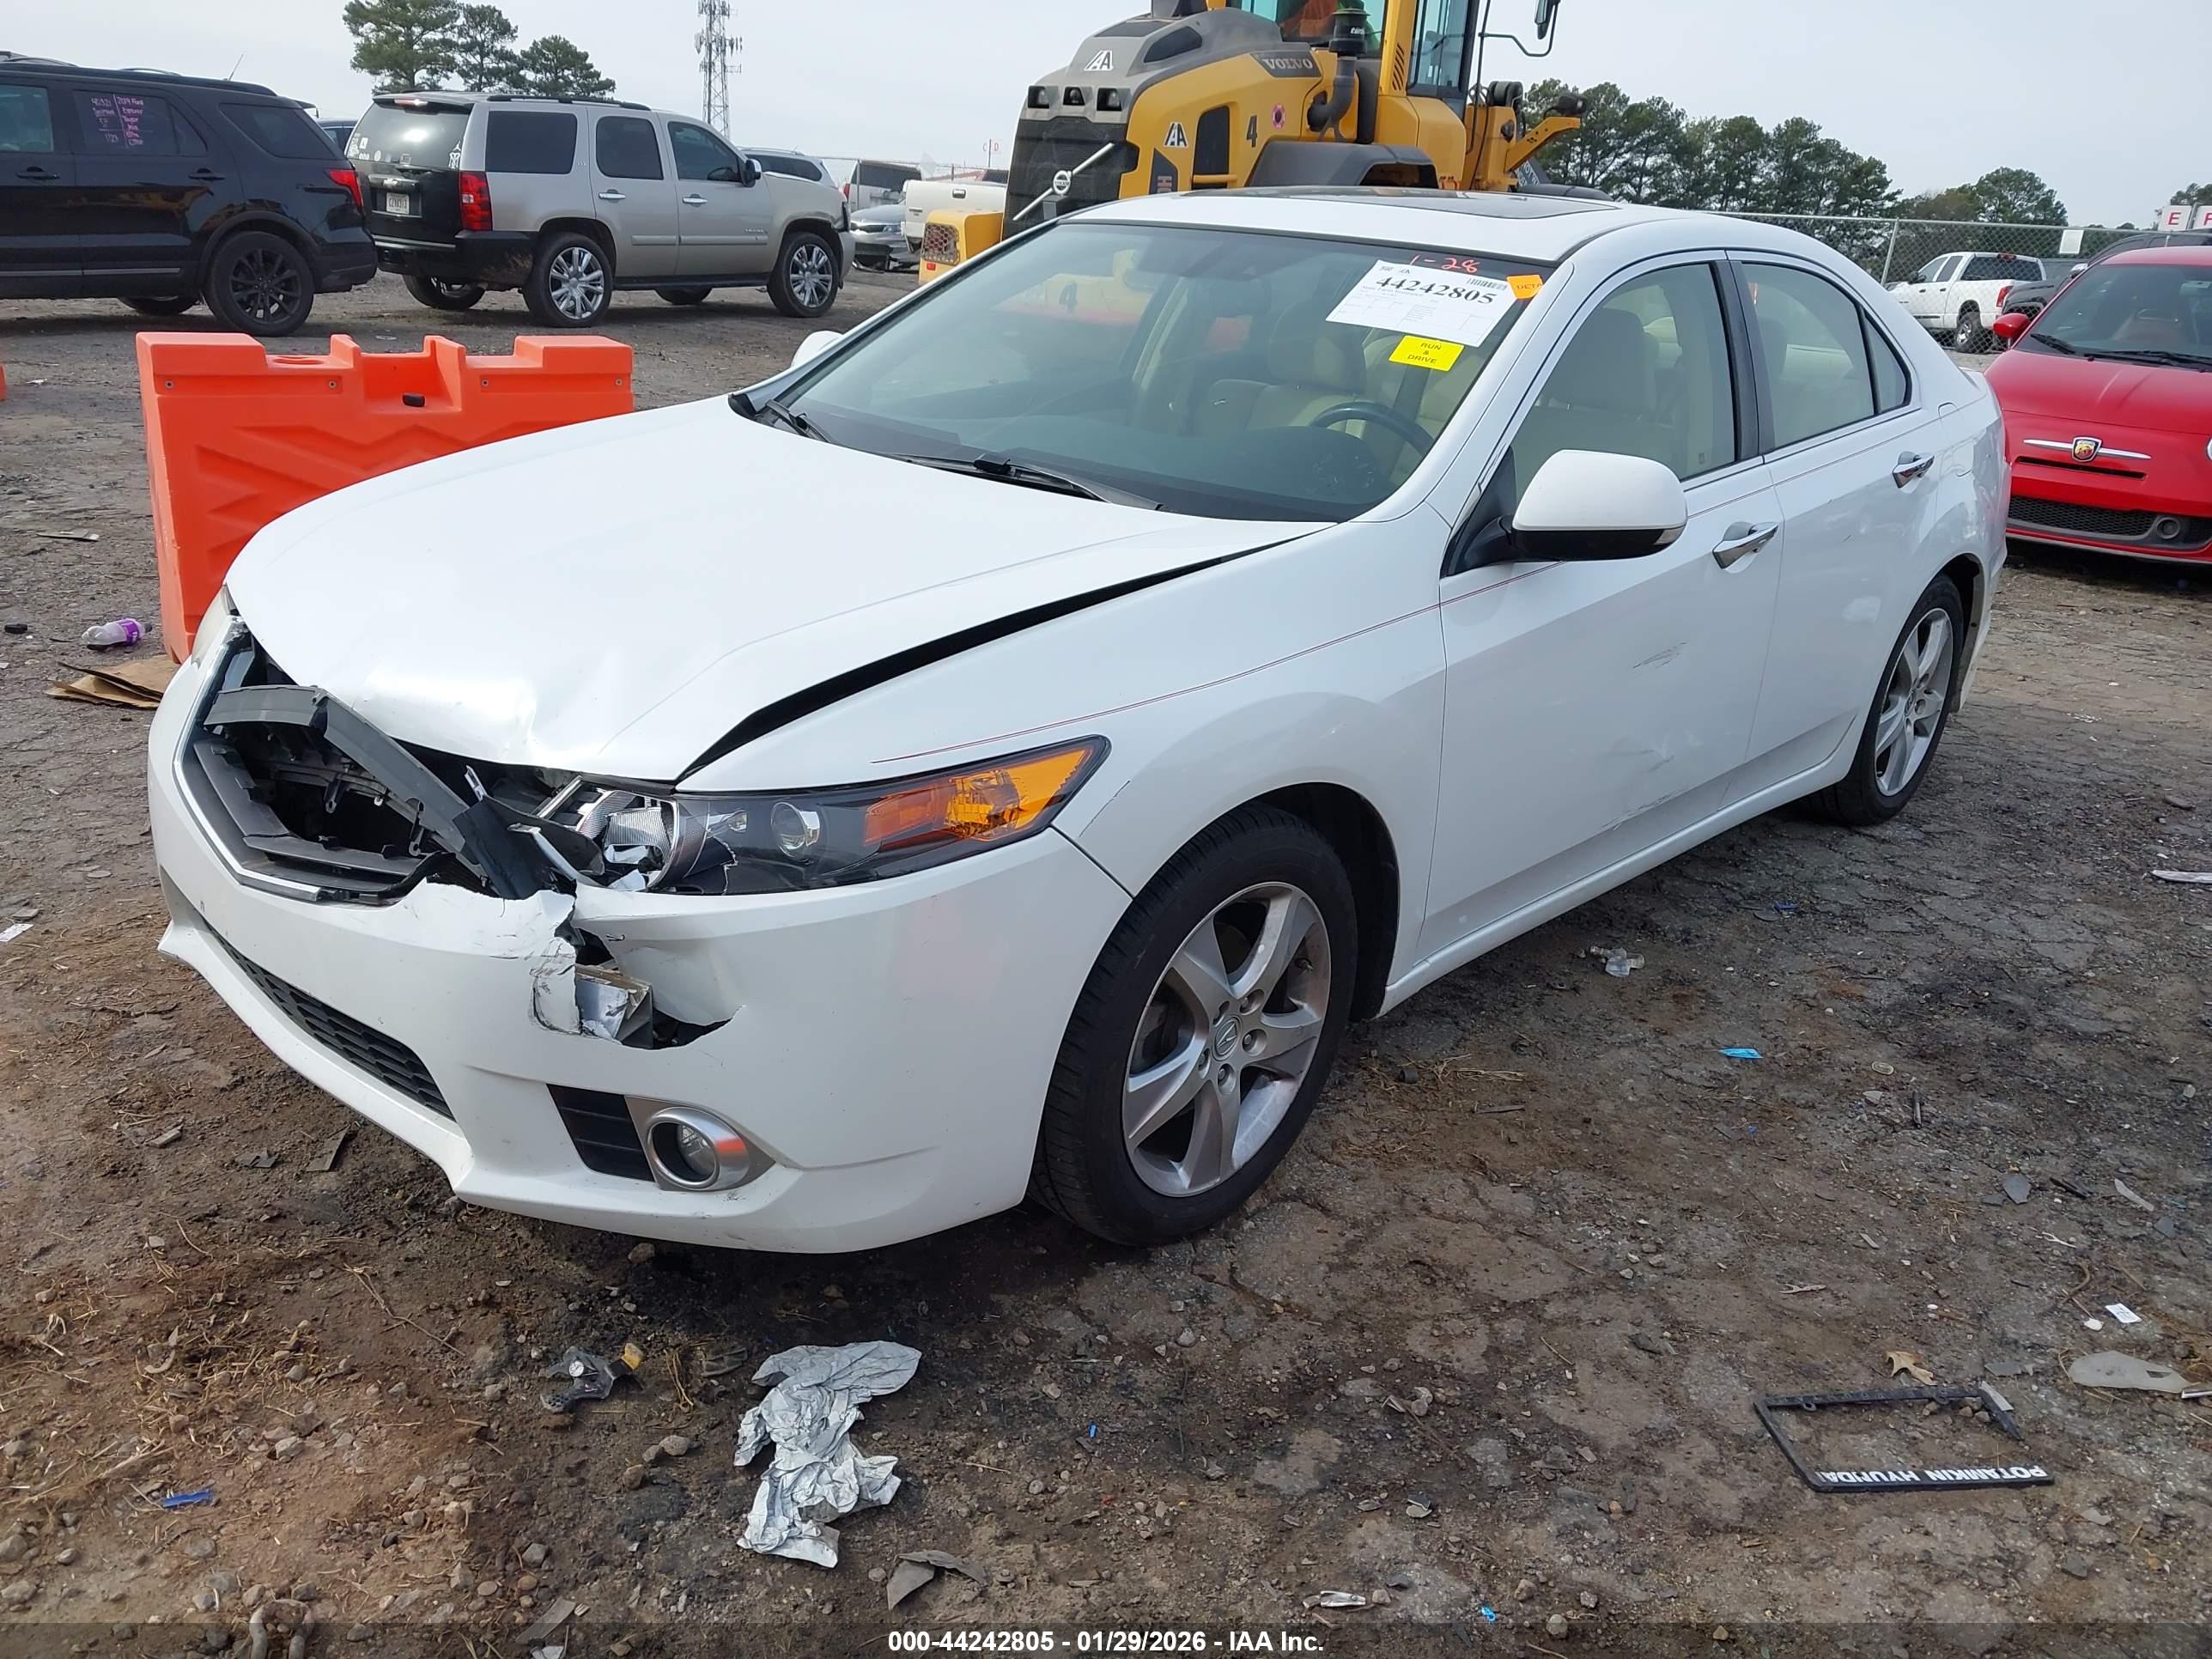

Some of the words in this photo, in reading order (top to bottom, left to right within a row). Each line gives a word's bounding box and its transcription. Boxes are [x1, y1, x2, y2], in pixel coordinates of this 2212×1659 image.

[1262, 58, 1313, 70] VOLVO
[1246, 114, 1258, 148] 4
[2167, 211, 2182, 225] E
[1376, 276, 1498, 304] 44242805
[1407, 354, 1438, 364] DRIVE
[1814, 1470, 1922, 1483] HYUNDAI
[1923, 1465, 2048, 1481] POTAMKIN
